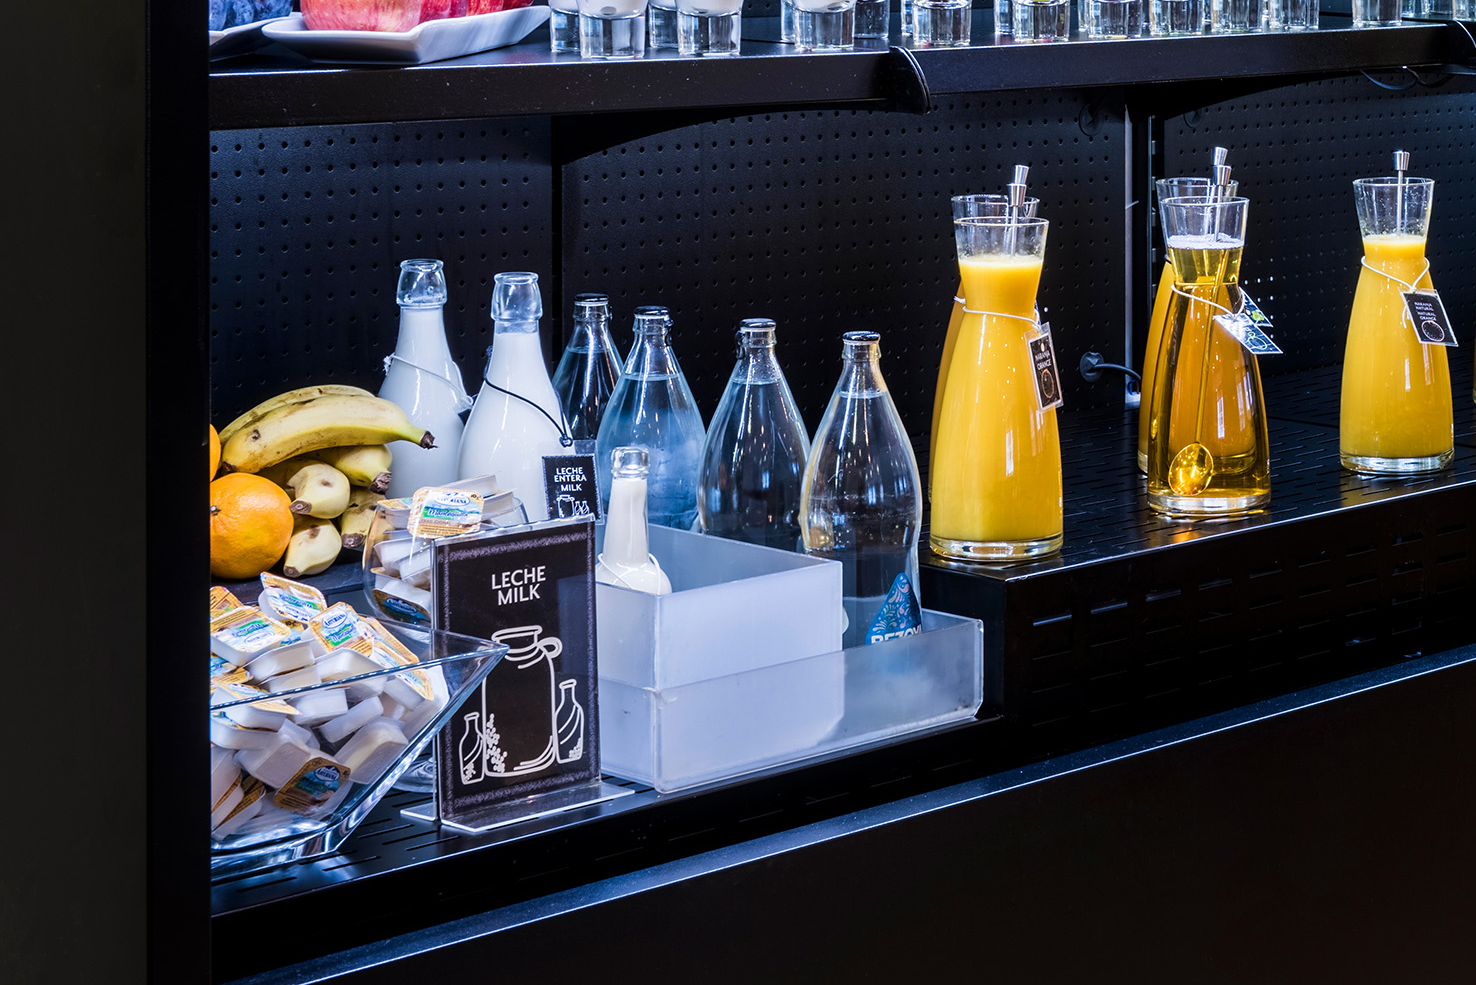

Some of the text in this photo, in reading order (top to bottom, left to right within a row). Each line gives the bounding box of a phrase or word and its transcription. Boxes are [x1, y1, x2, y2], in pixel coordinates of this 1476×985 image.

[556, 467, 583, 475] LECHE
[554, 474, 587, 483] ENTERA
[561, 483, 582, 492] MILK
[491, 565, 546, 590] LECHE
[497, 583, 541, 606] MILK
